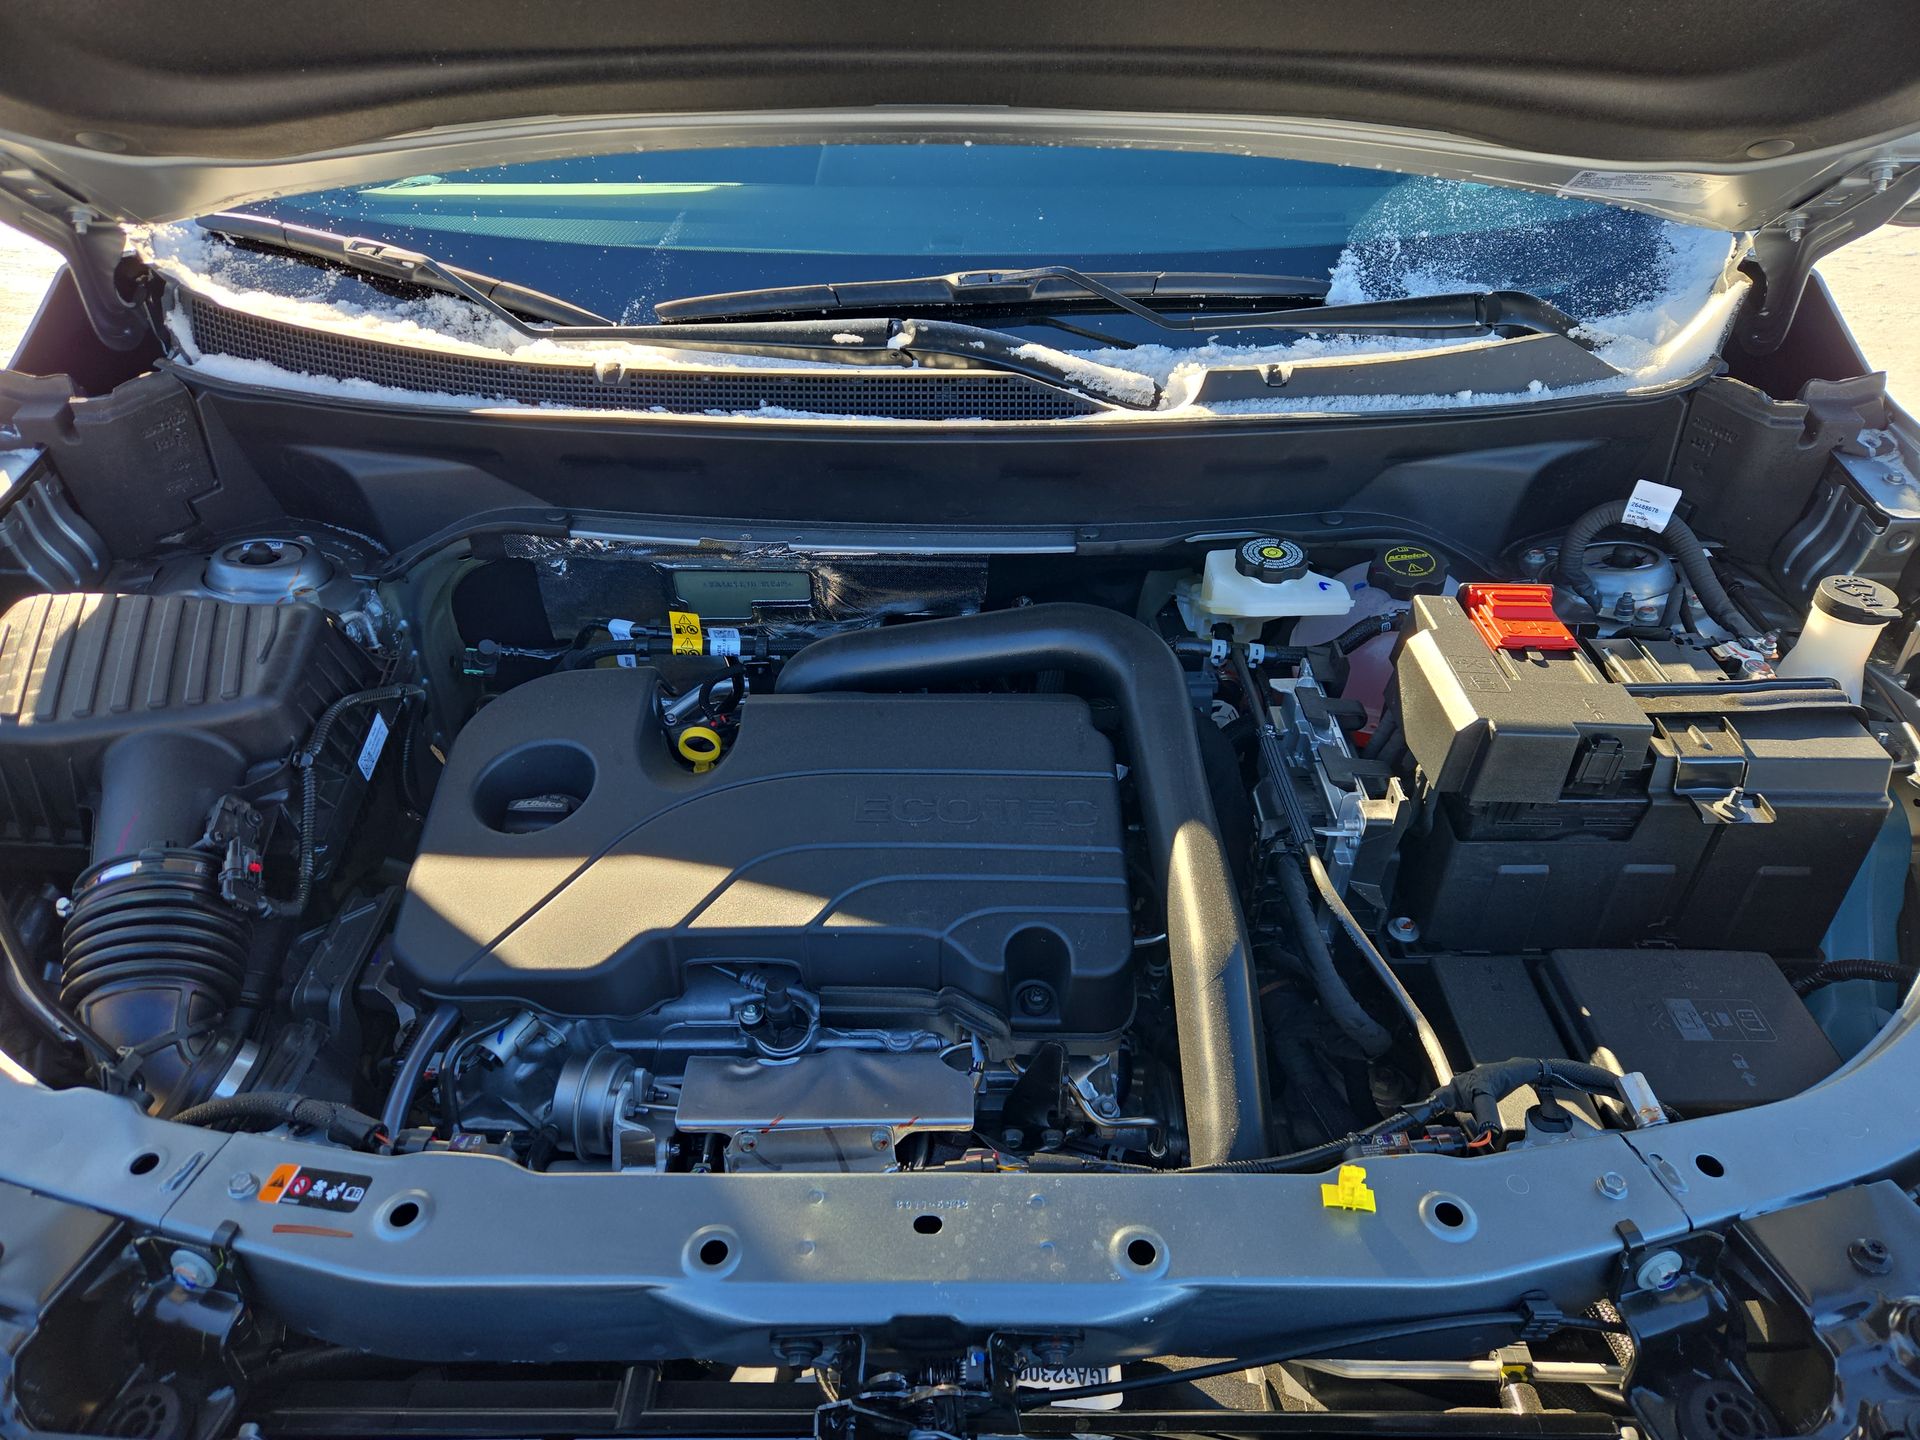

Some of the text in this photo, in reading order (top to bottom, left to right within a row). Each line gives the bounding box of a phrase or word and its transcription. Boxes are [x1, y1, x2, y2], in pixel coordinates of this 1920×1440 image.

[1388, 552, 1429, 562] ACDelco
[512, 800, 563, 809] ACDelco
[855, 797, 1101, 827] ECOTEC
